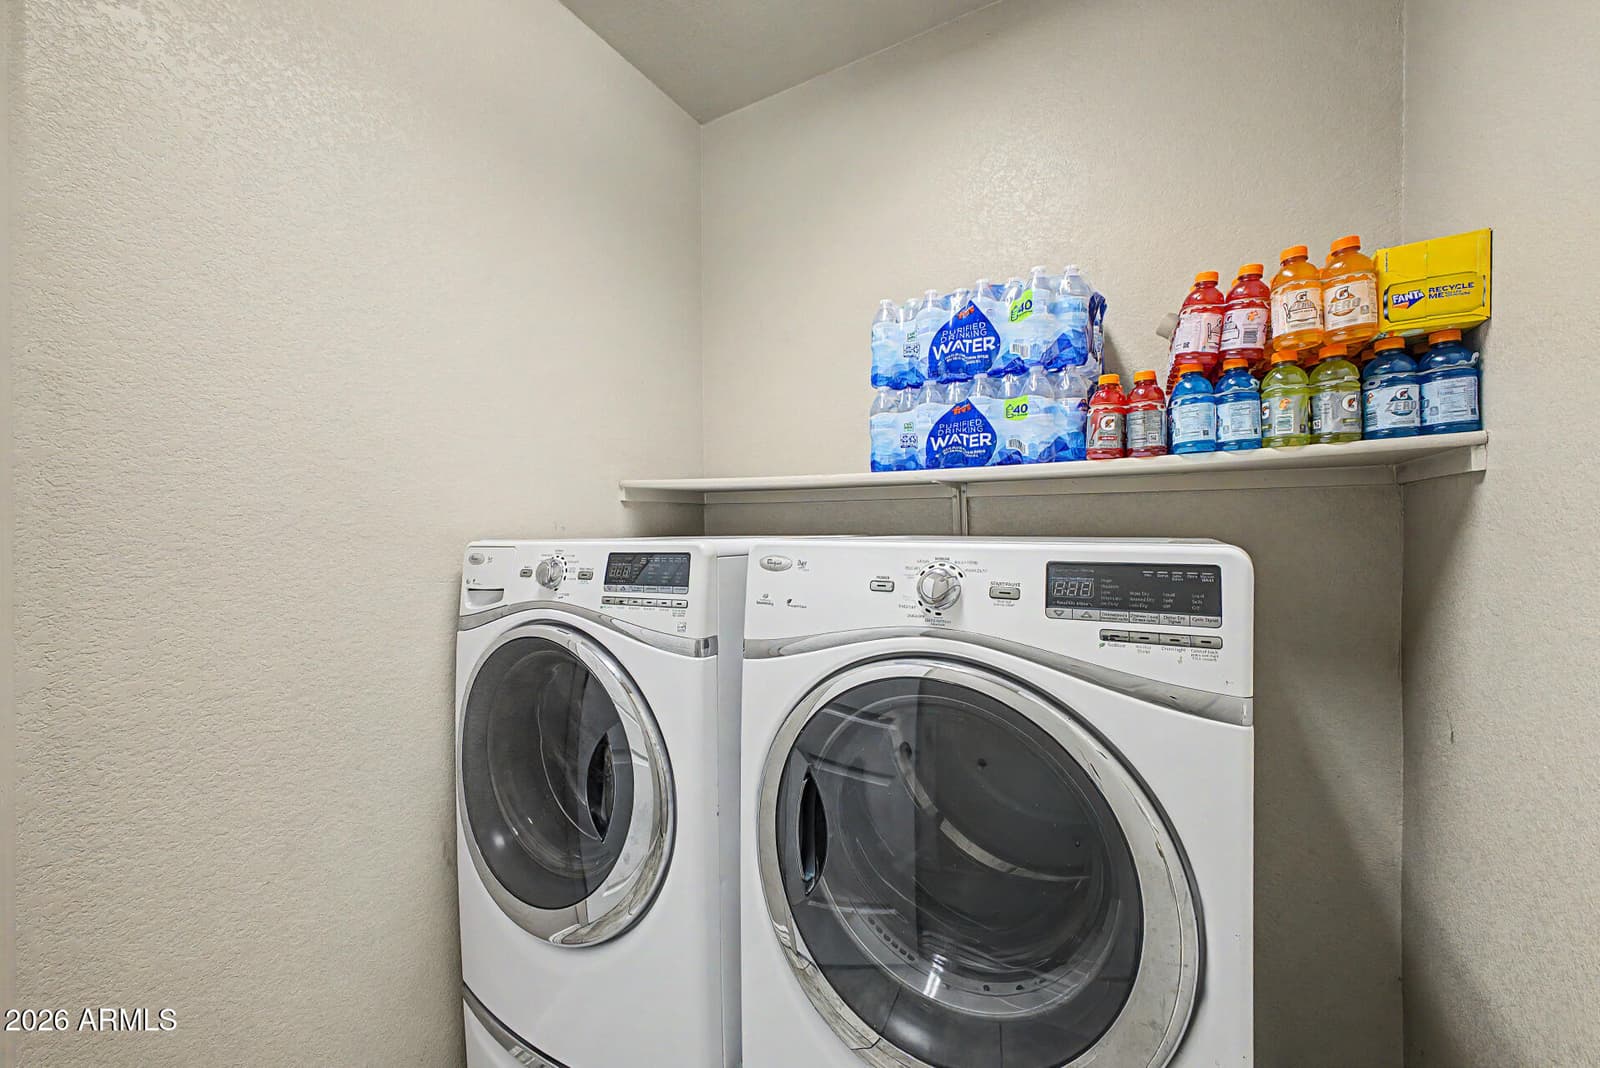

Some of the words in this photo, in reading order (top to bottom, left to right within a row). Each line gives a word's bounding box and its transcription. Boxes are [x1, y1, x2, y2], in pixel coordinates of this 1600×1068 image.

[1428, 282, 1475, 293] RECYCLE
[1018, 299, 1033, 313] 40
[1327, 297, 1361, 315] ZERO
[940, 328, 988, 343] DRINKING
[942, 322, 986, 337] PURIFIED
[932, 336, 996, 360] WATER
[1013, 403, 1029, 414] 40
[1385, 400, 1417, 413] ZERO
[937, 425, 984, 437] DRINKING
[939, 418, 983, 431] PURIFIED
[929, 432, 993, 451] WATER
